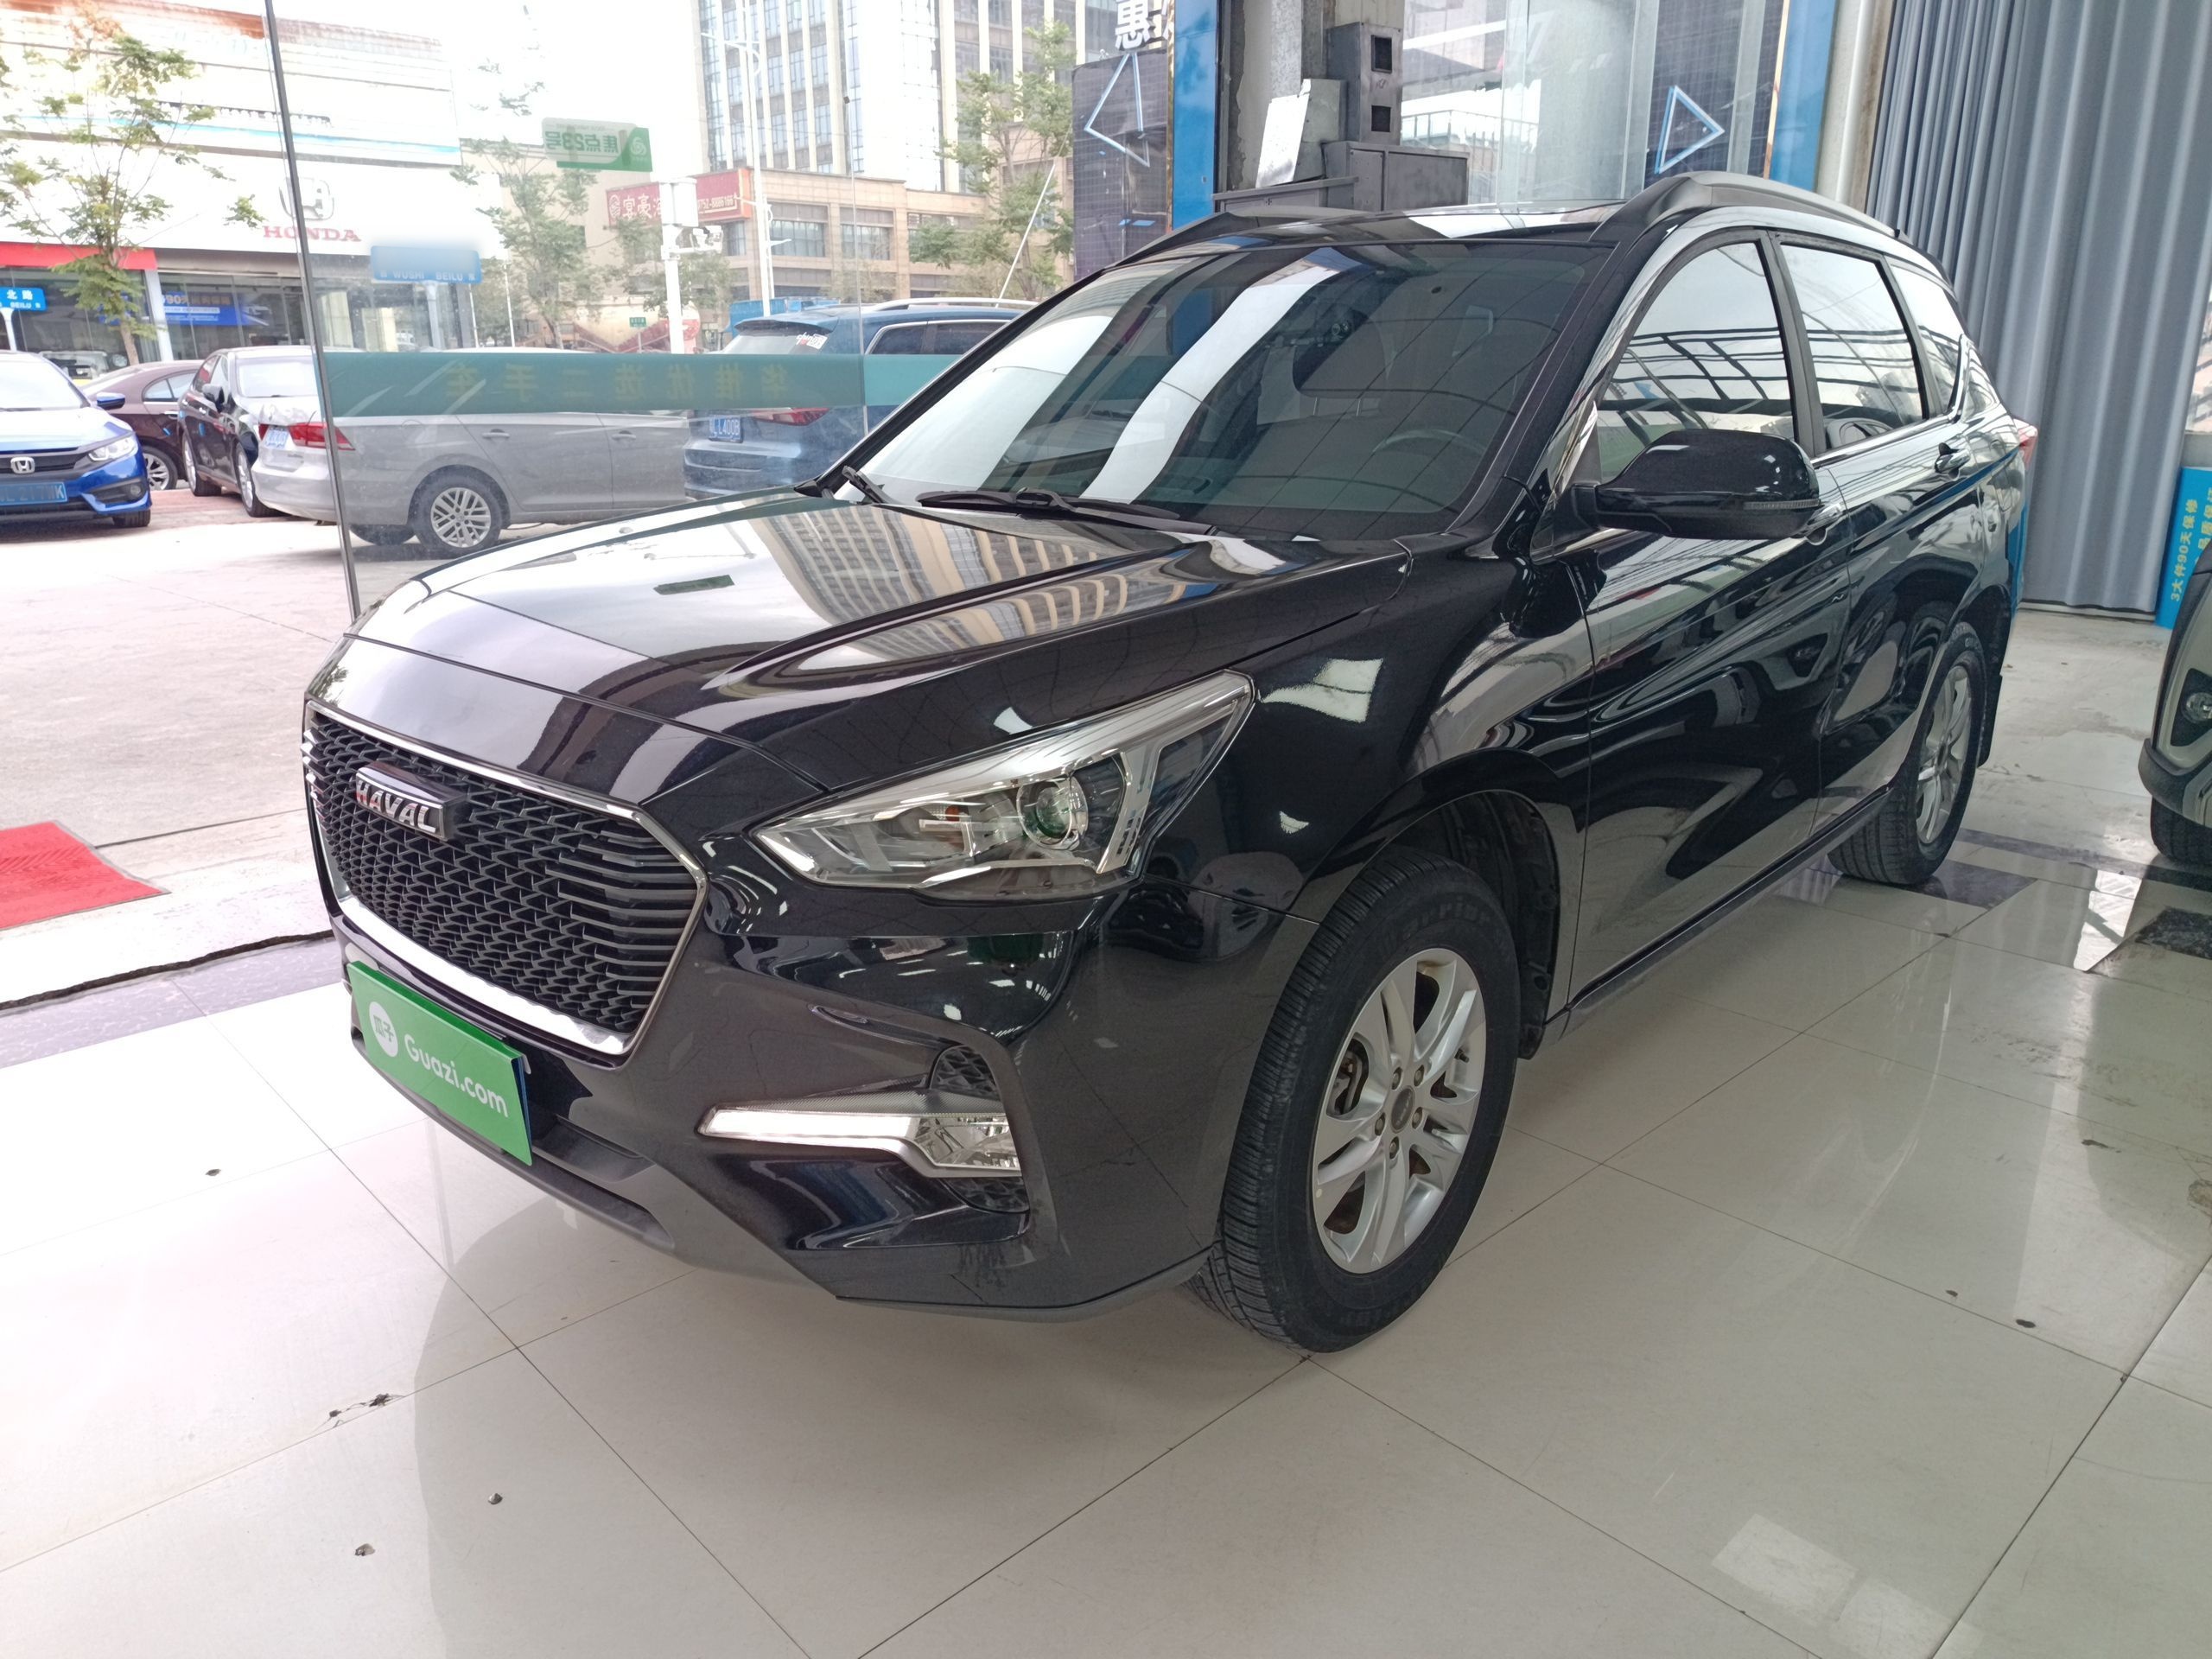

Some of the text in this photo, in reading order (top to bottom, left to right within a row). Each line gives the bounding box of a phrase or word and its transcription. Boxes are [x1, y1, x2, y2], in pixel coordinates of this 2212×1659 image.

[1115, 0, 1168, 49] 惠
[262, 226, 362, 242] HONDA
[392, 270, 425, 279] WUSHI
[435, 271, 463, 281] BEILU
[2170, 499, 2198, 602] 3大件90天保修
[356, 780, 436, 833] HAVAL
[373, 1015, 394, 1043] 瓜子
[404, 1033, 508, 1118] Guazi.com
